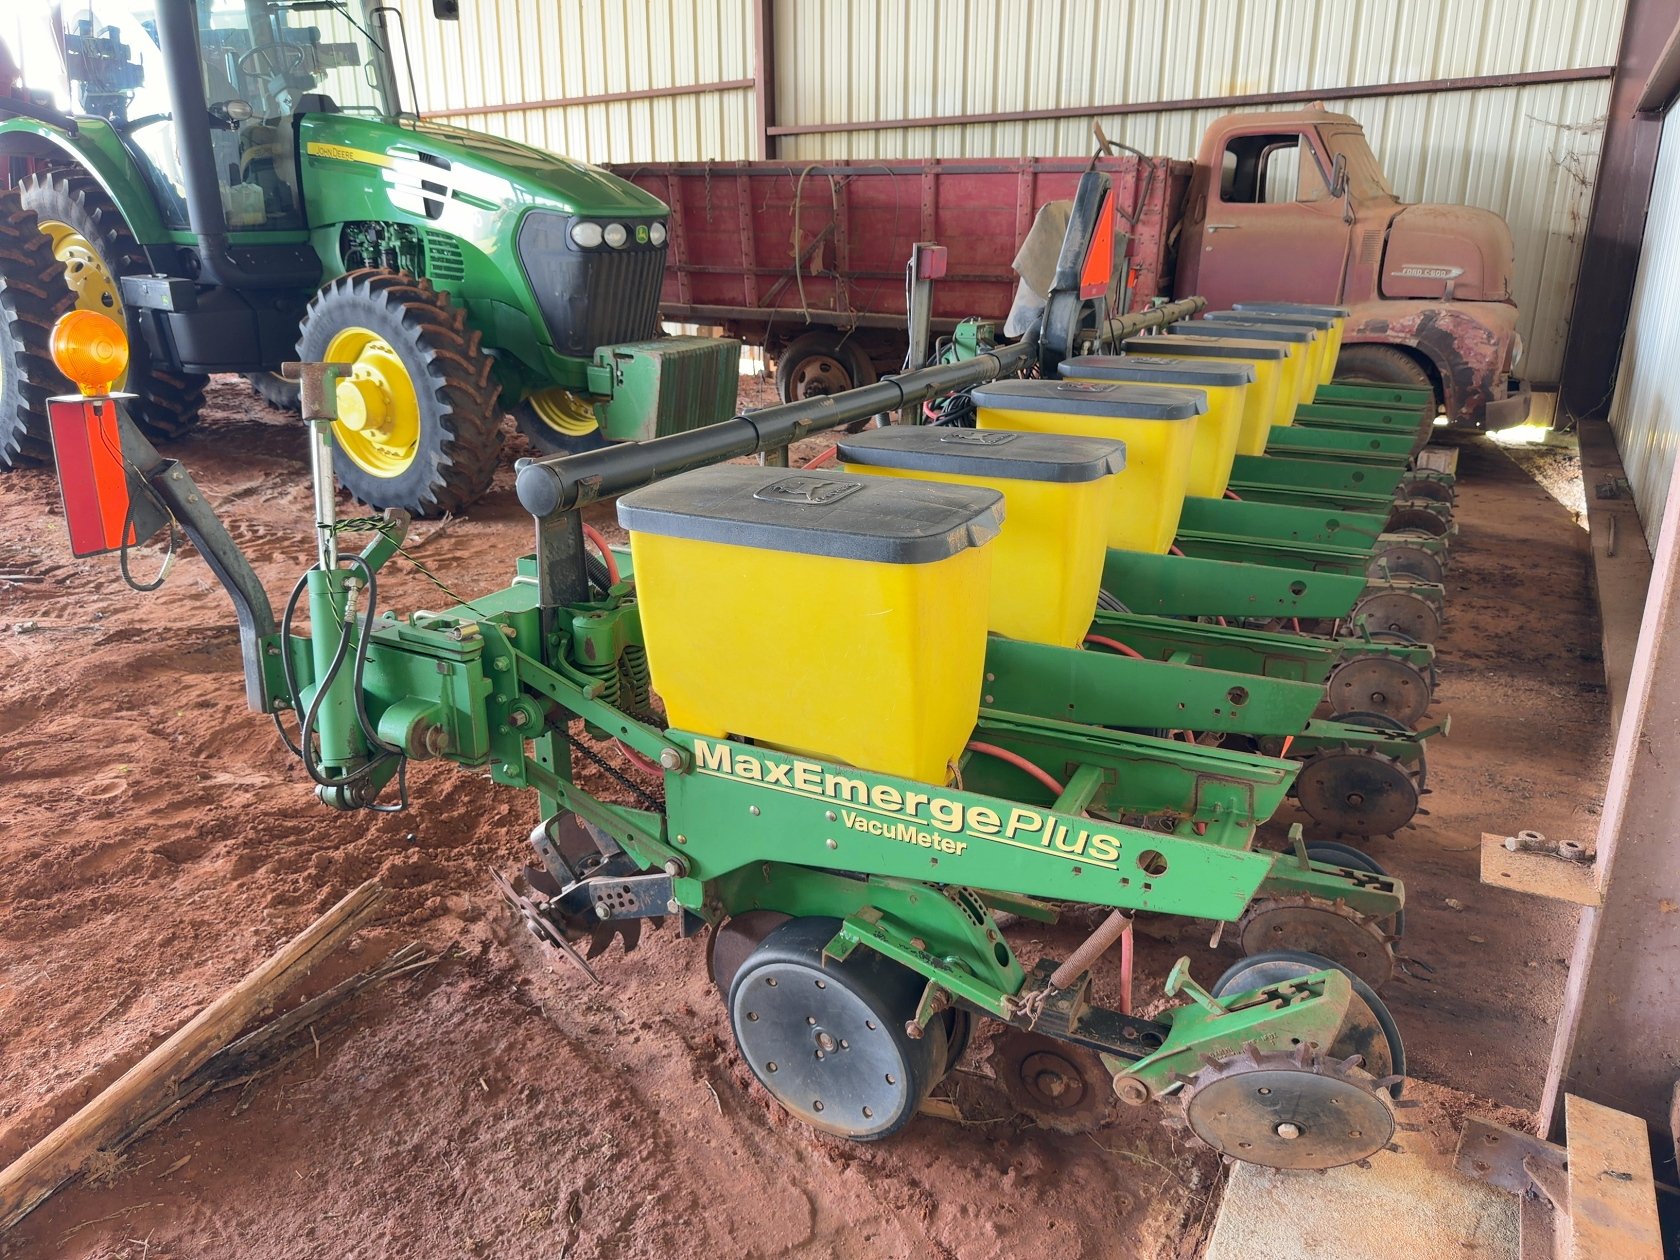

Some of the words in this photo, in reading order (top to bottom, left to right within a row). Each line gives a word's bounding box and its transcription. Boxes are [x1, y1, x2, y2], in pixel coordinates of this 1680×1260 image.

[316, 146, 333, 157] JOHN
[332, 147, 354, 160] DEERE
[1402, 268, 1422, 276] FORD
[841, 809, 967, 856] VacuMeter
